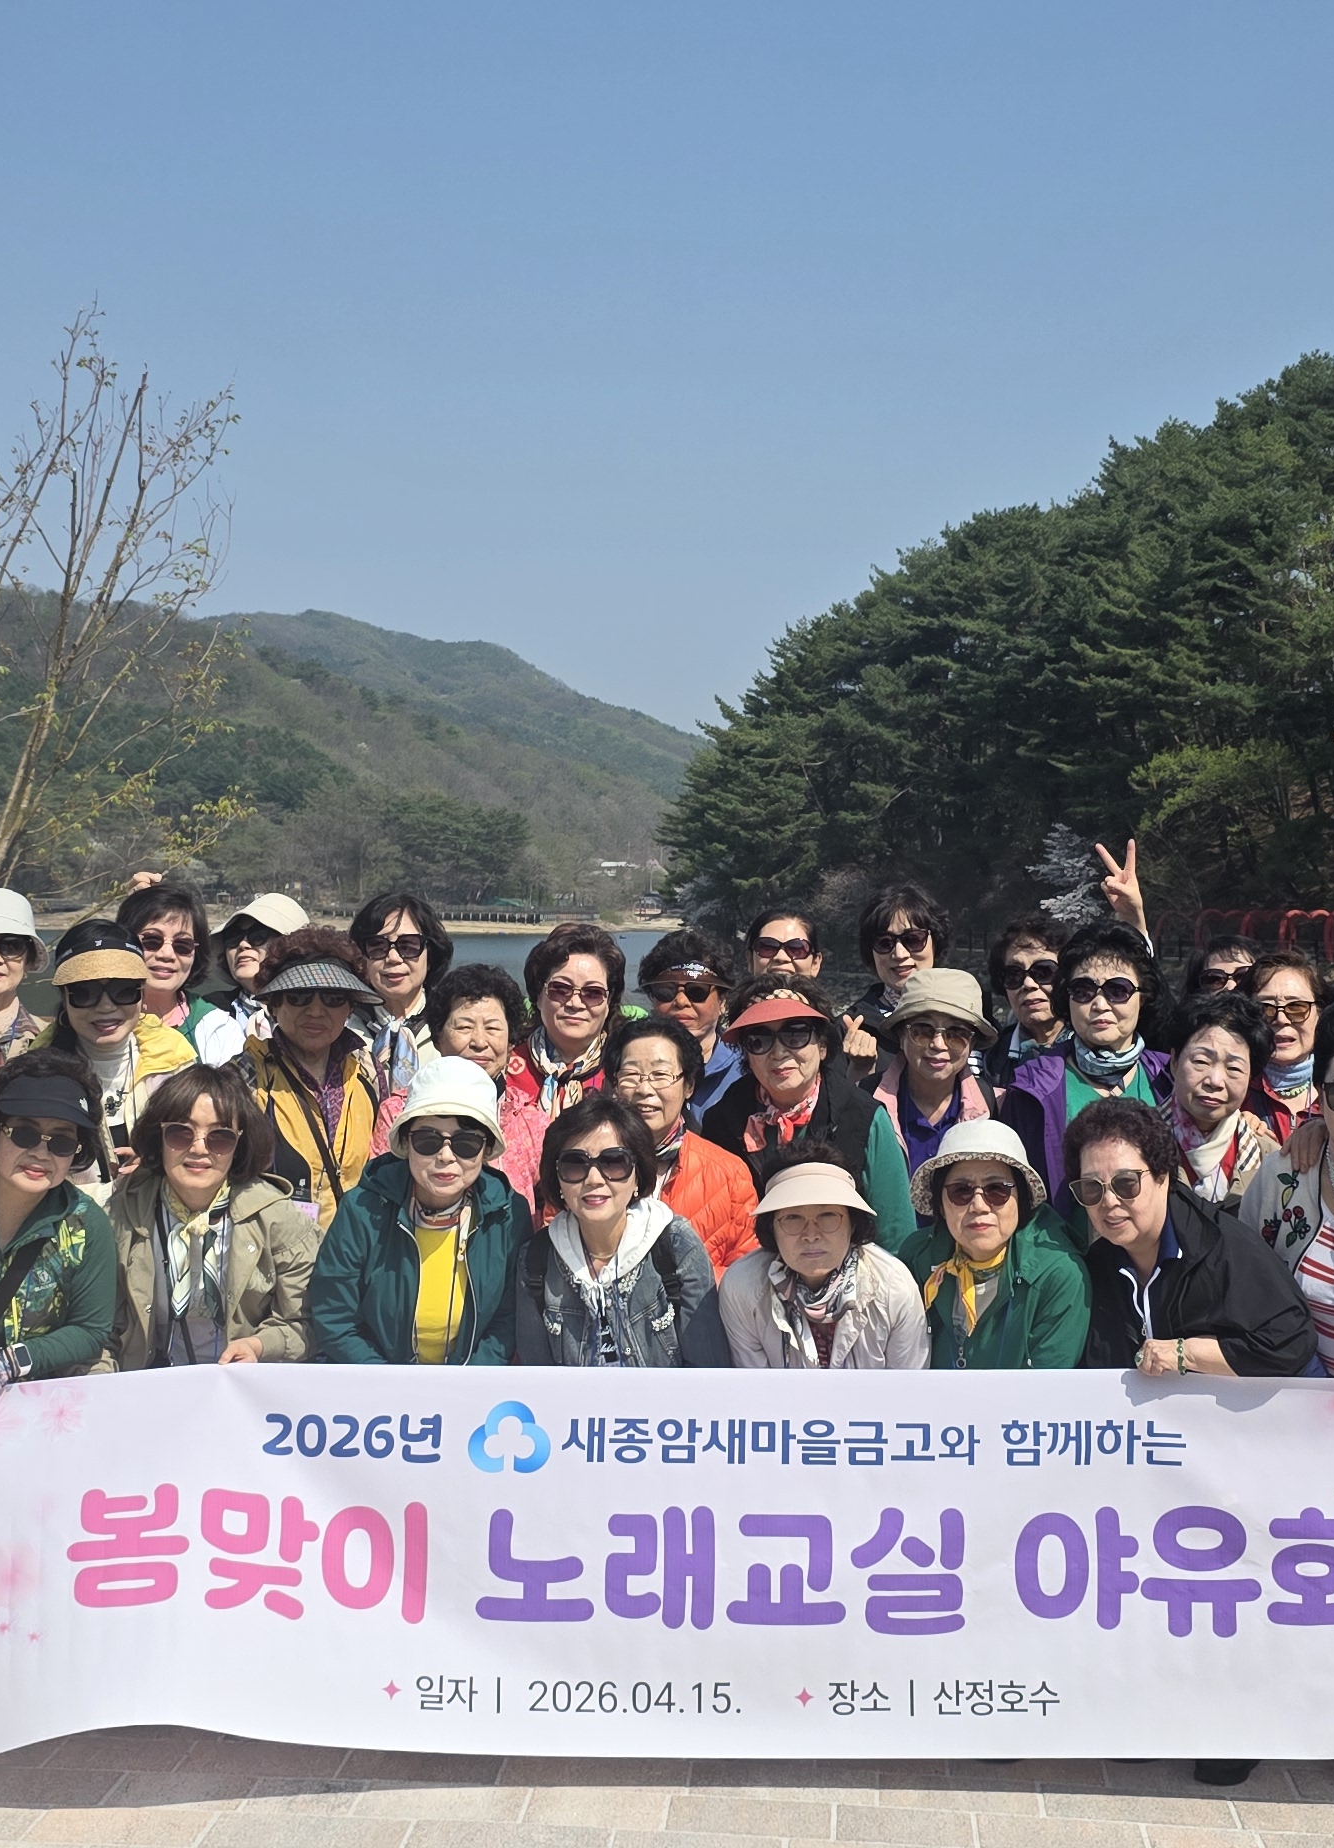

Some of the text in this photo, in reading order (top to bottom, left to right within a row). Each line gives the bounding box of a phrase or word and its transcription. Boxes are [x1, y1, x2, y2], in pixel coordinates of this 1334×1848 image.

[262, 1413, 1187, 1467] 2026년 새종암새마을금고와 함께하는
[66, 1483, 429, 1625] 봄맞이
[475, 1505, 966, 1636] 노래교실
[416, 1675, 479, 1713] 일자
[528, 1680, 741, 1714] 2026.04.15.
[828, 1679, 892, 1716] 장소
[933, 1679, 1061, 1717] 산정호수
